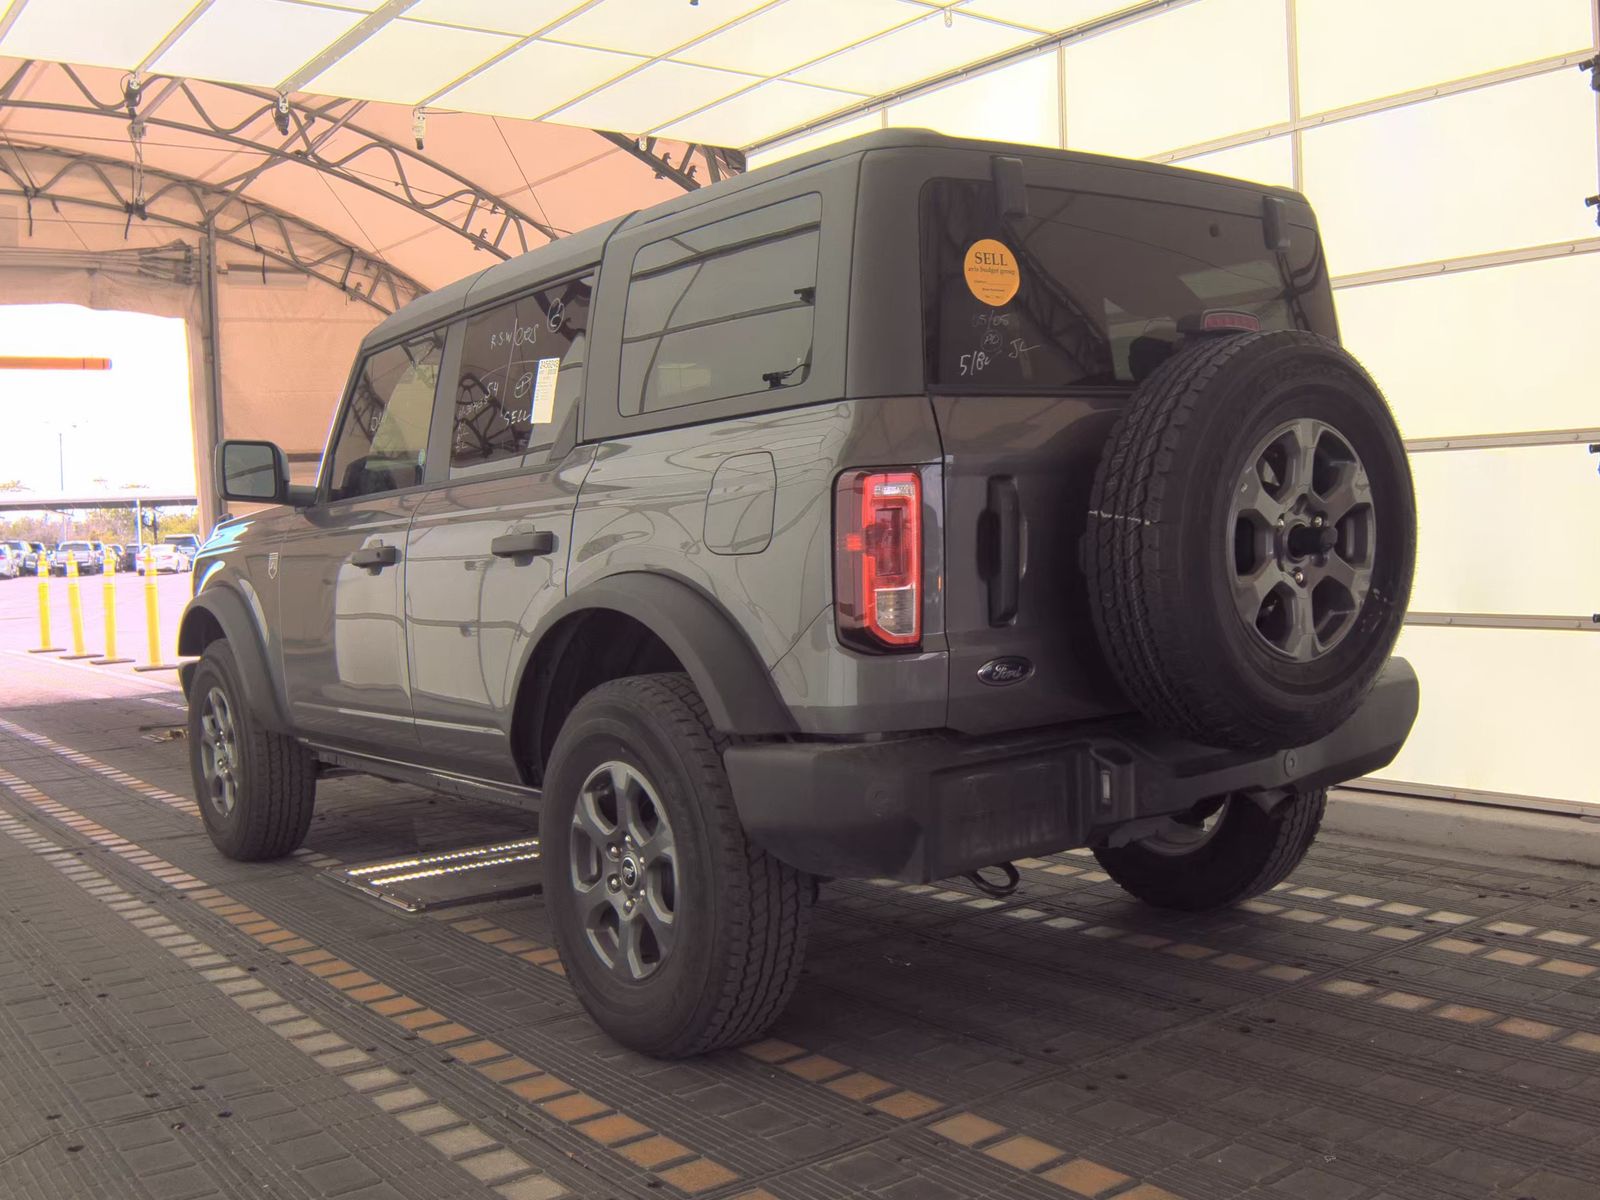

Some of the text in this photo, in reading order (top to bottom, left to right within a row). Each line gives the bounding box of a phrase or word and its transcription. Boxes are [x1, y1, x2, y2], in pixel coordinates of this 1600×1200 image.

[974, 251, 1008, 267] SELL
[503, 409, 531, 426] SELL
[991, 663, 1023, 681] Ford
